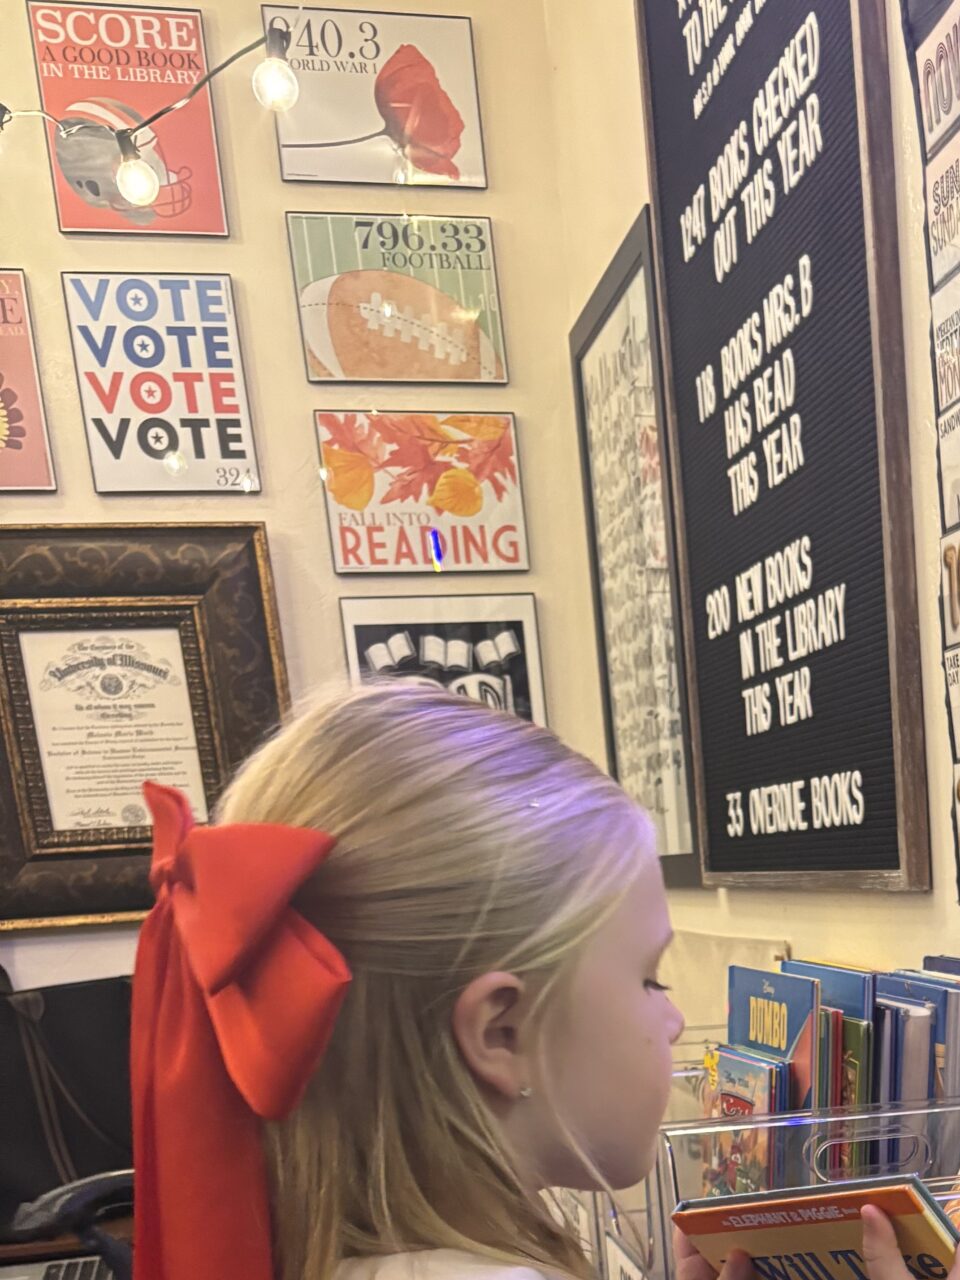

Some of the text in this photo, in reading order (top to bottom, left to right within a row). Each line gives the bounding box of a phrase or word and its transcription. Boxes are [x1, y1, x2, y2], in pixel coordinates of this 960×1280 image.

[35, 9, 197, 51] SCORE
[683, 10, 702, 76] TO
[41, 63, 201, 84] IN THE LIBRARY
[42, 45, 201, 70] A GOOD BOOK
[334, 61, 368, 74] WAR
[680, 184, 707, 263] 1247
[709, 120, 750, 223] BOOKS
[752, 11, 820, 156] CHECKED
[713, 93, 823, 283] OUT THIS YEAR
[932, 158, 960, 216] SUN
[354, 221, 487, 253] 796.33
[381, 252, 491, 271] FOOTBALL
[70, 279, 227, 322] VOTE
[77, 325, 234, 368] VOTE
[696, 254, 813, 423] 118 BOOKS MRS. B
[84, 372, 241, 414] VOTE
[724, 348, 797, 460] HAS READ
[91, 418, 248, 461] VOTE
[727, 413, 804, 516] THIS YEAR
[338, 512, 431, 527] FALL INTO
[338, 525, 520, 566] READING
[705, 534, 813, 640] 200 NEW BOOKS
[739, 583, 846, 680] IN THE LIBRARY
[742, 666, 814, 736] THIS YEAR
[749, 780, 808, 835] OVERDUE
[811, 769, 866, 829] BOOKS
[749, 995, 788, 1051] DUMBO
[730, 1205, 844, 1229] ELEPHANT PIGGIE
